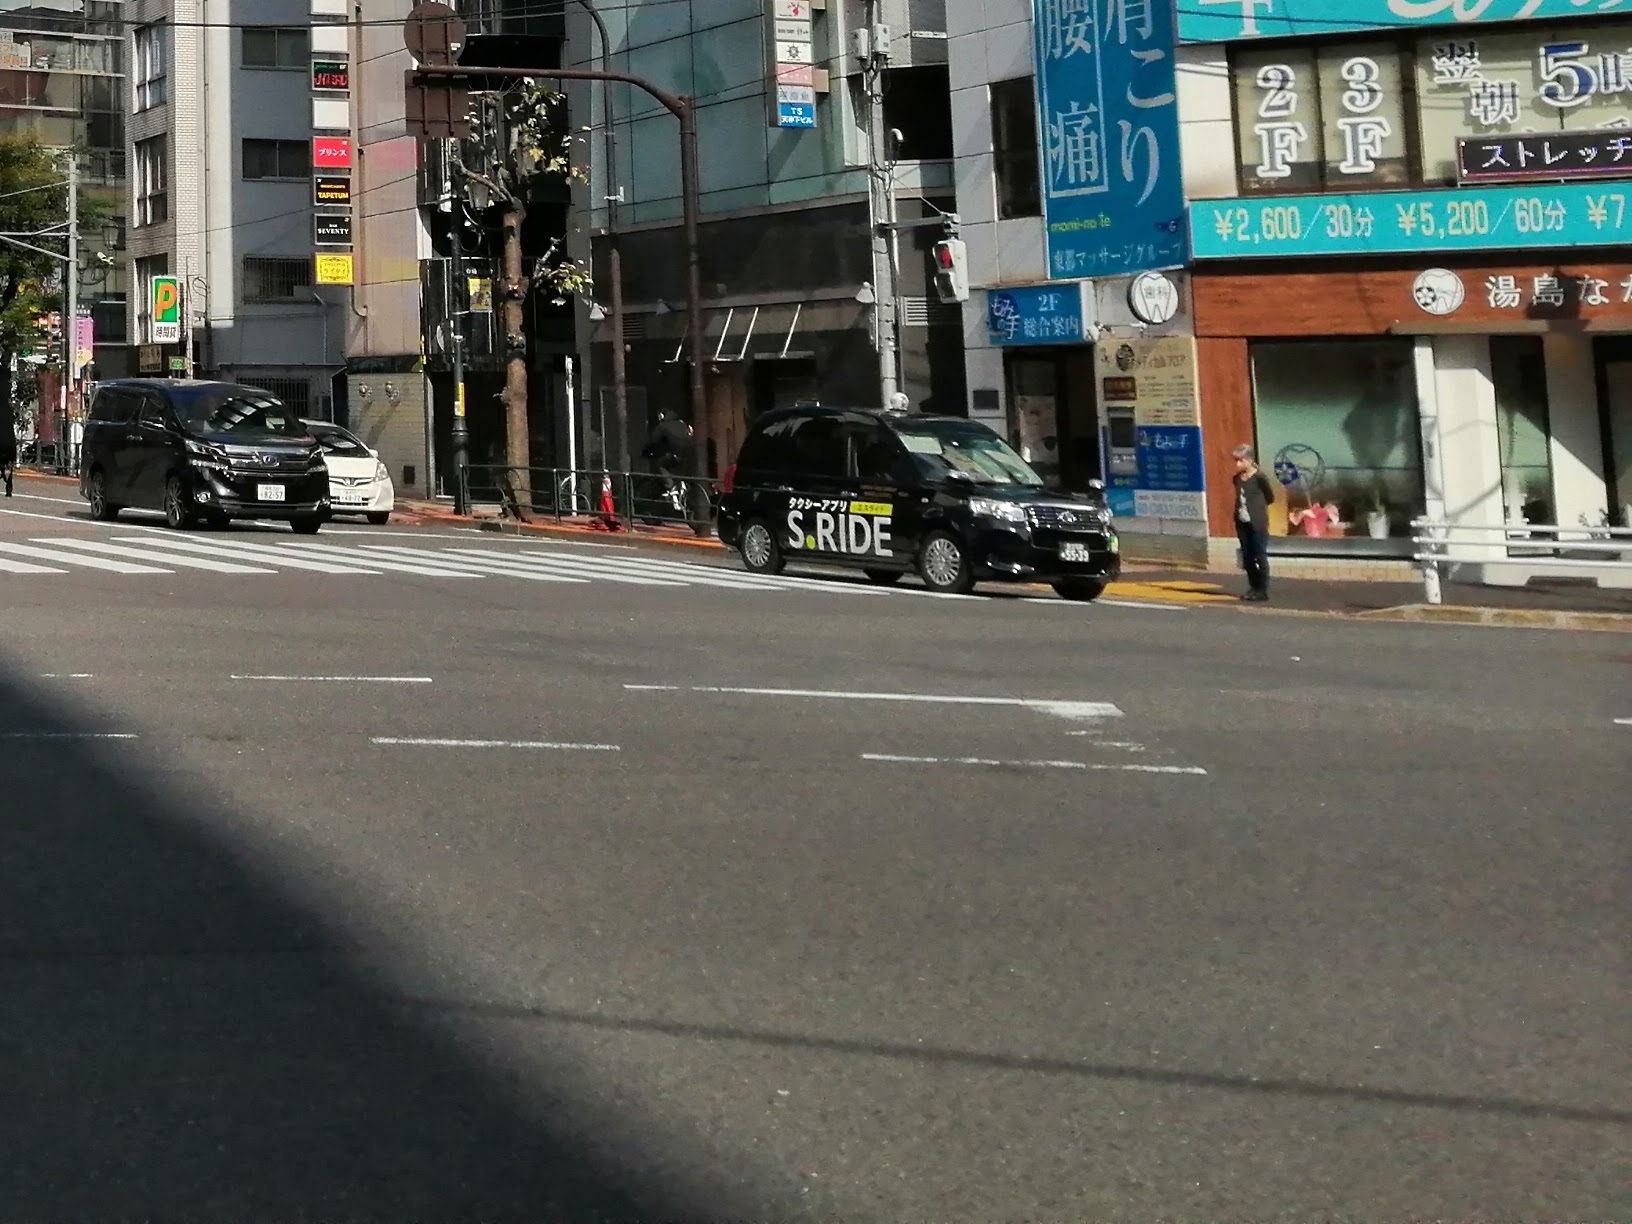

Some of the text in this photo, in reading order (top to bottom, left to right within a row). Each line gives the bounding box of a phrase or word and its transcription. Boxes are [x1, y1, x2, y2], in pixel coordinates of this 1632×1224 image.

[790, 107, 803, 116] TS
[1254, 64, 1308, 178] 2F
[1336, 57, 1392, 175] 3F
[318, 148, 347, 157] プリンス
[1481, 136, 1632, 169] ストレッチ
[317, 191, 349, 199] TAPETUM
[317, 227, 349, 235] SEVENTY
[155, 282, 177, 320] P
[1037, 293, 1062, 312] 2F
[156, 326, 177, 338] 時間貸
[1023, 315, 1079, 337] 総合案内
[788, 497, 848, 513] タクシーアプリ
[787, 509, 894, 557] S.RIDE
